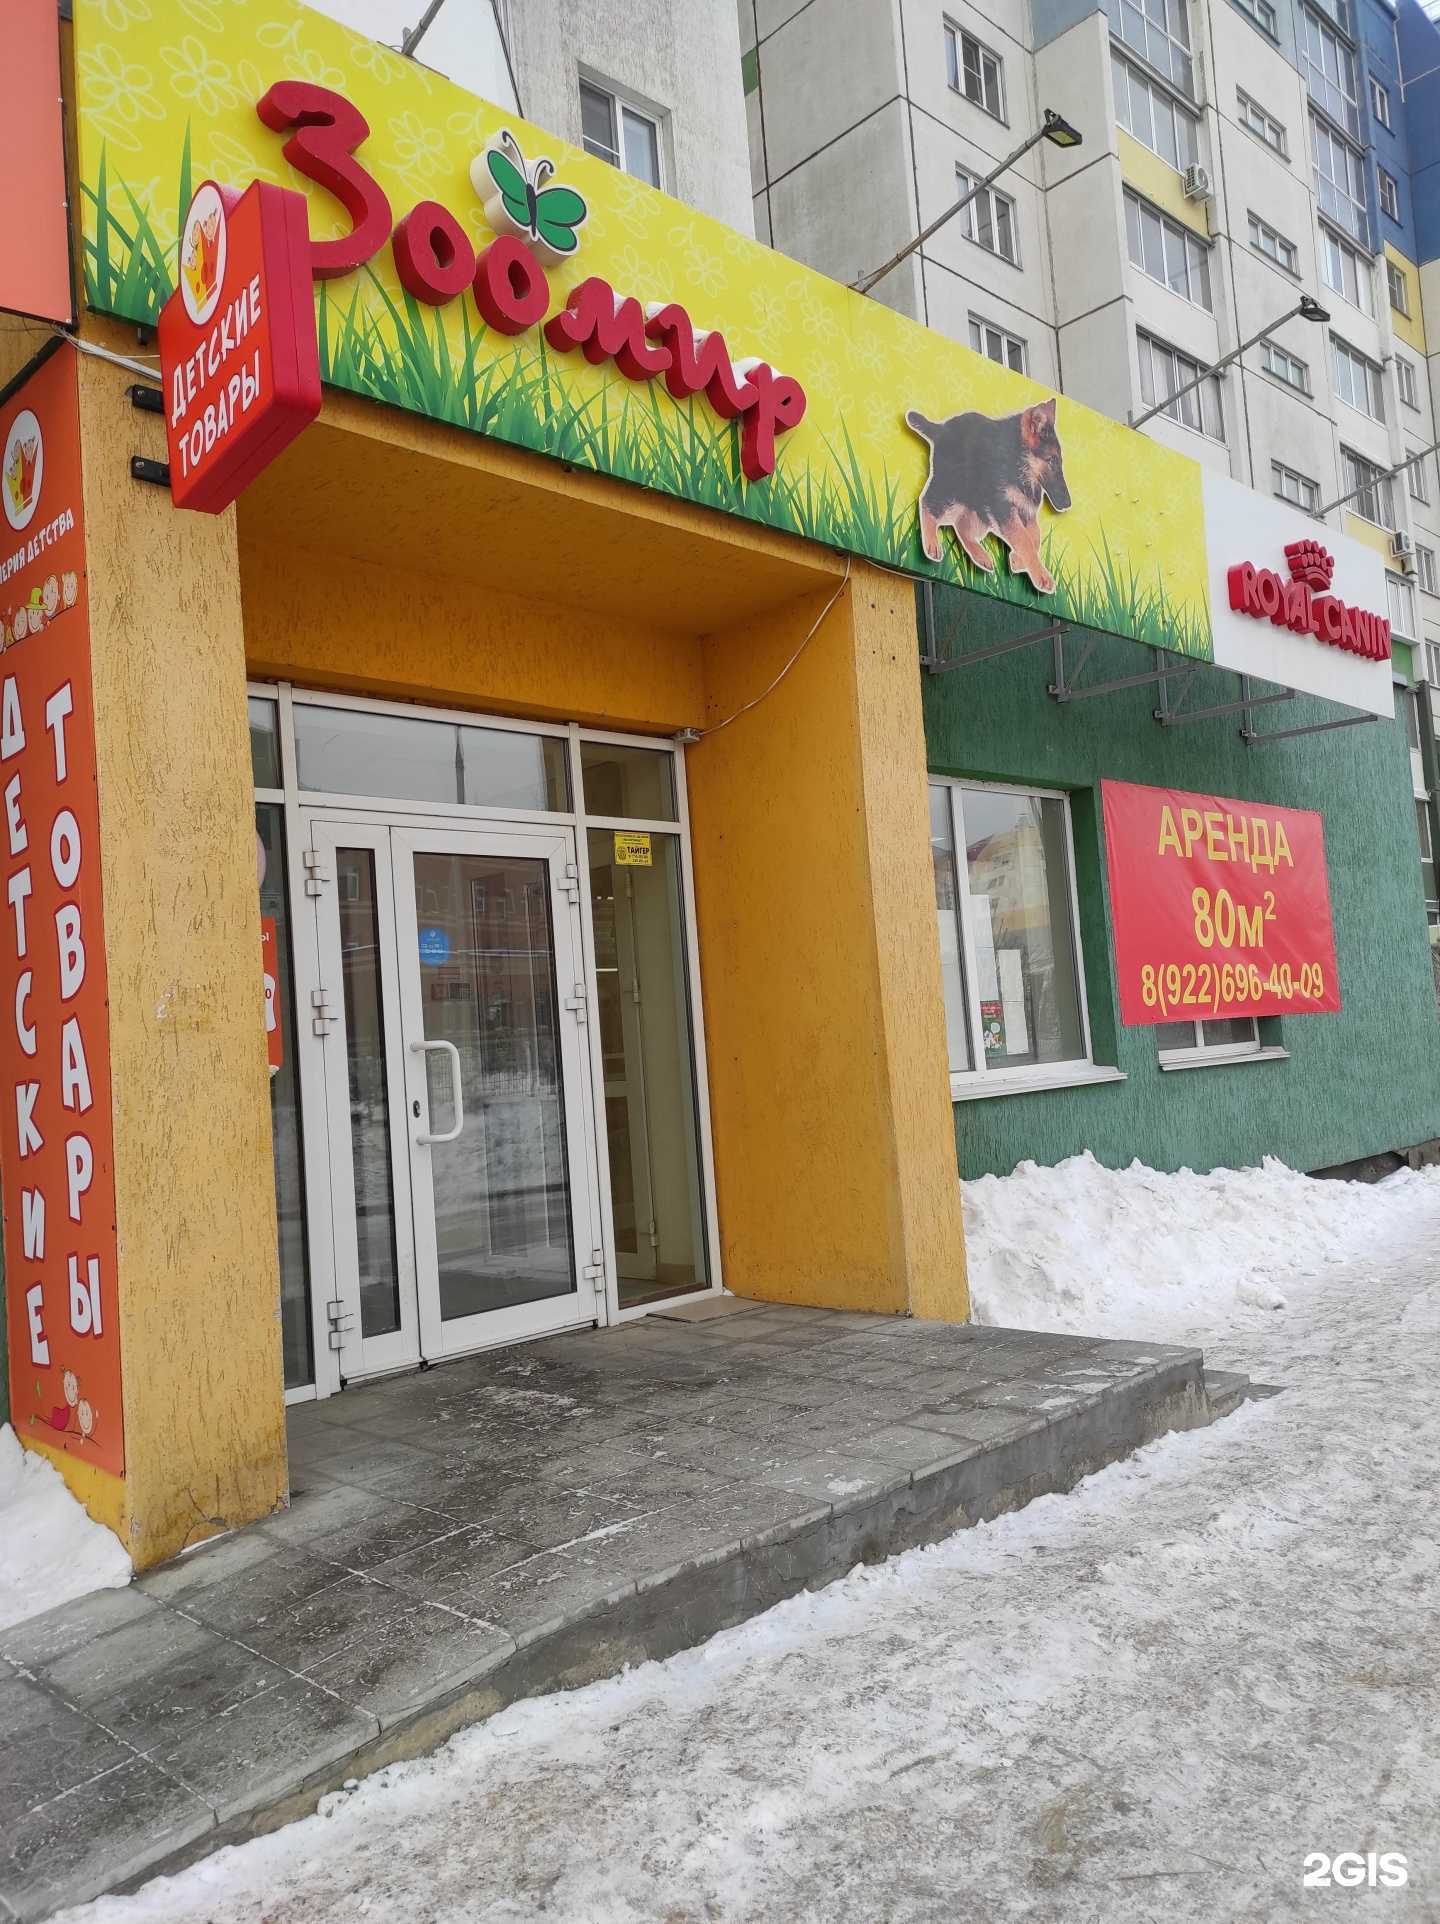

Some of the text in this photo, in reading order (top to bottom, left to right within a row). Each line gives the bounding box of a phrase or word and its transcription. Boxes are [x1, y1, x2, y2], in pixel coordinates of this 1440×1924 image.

[171, 273, 262, 428] ДЕТСКИЕ
[179, 350, 260, 478] ТОВАРЫ
[27, 507, 75, 563] ДЕТСТВА
[1227, 561, 1391, 661] ROYAL CANIN
[1158, 805, 1294, 874] АРЕНДА
[0, 674, 51, 1367] ДЕТСКИЕ
[45, 679, 103, 1339] ТОВАРЫ
[1141, 963, 1324, 1016] 8(922)696-40-09
